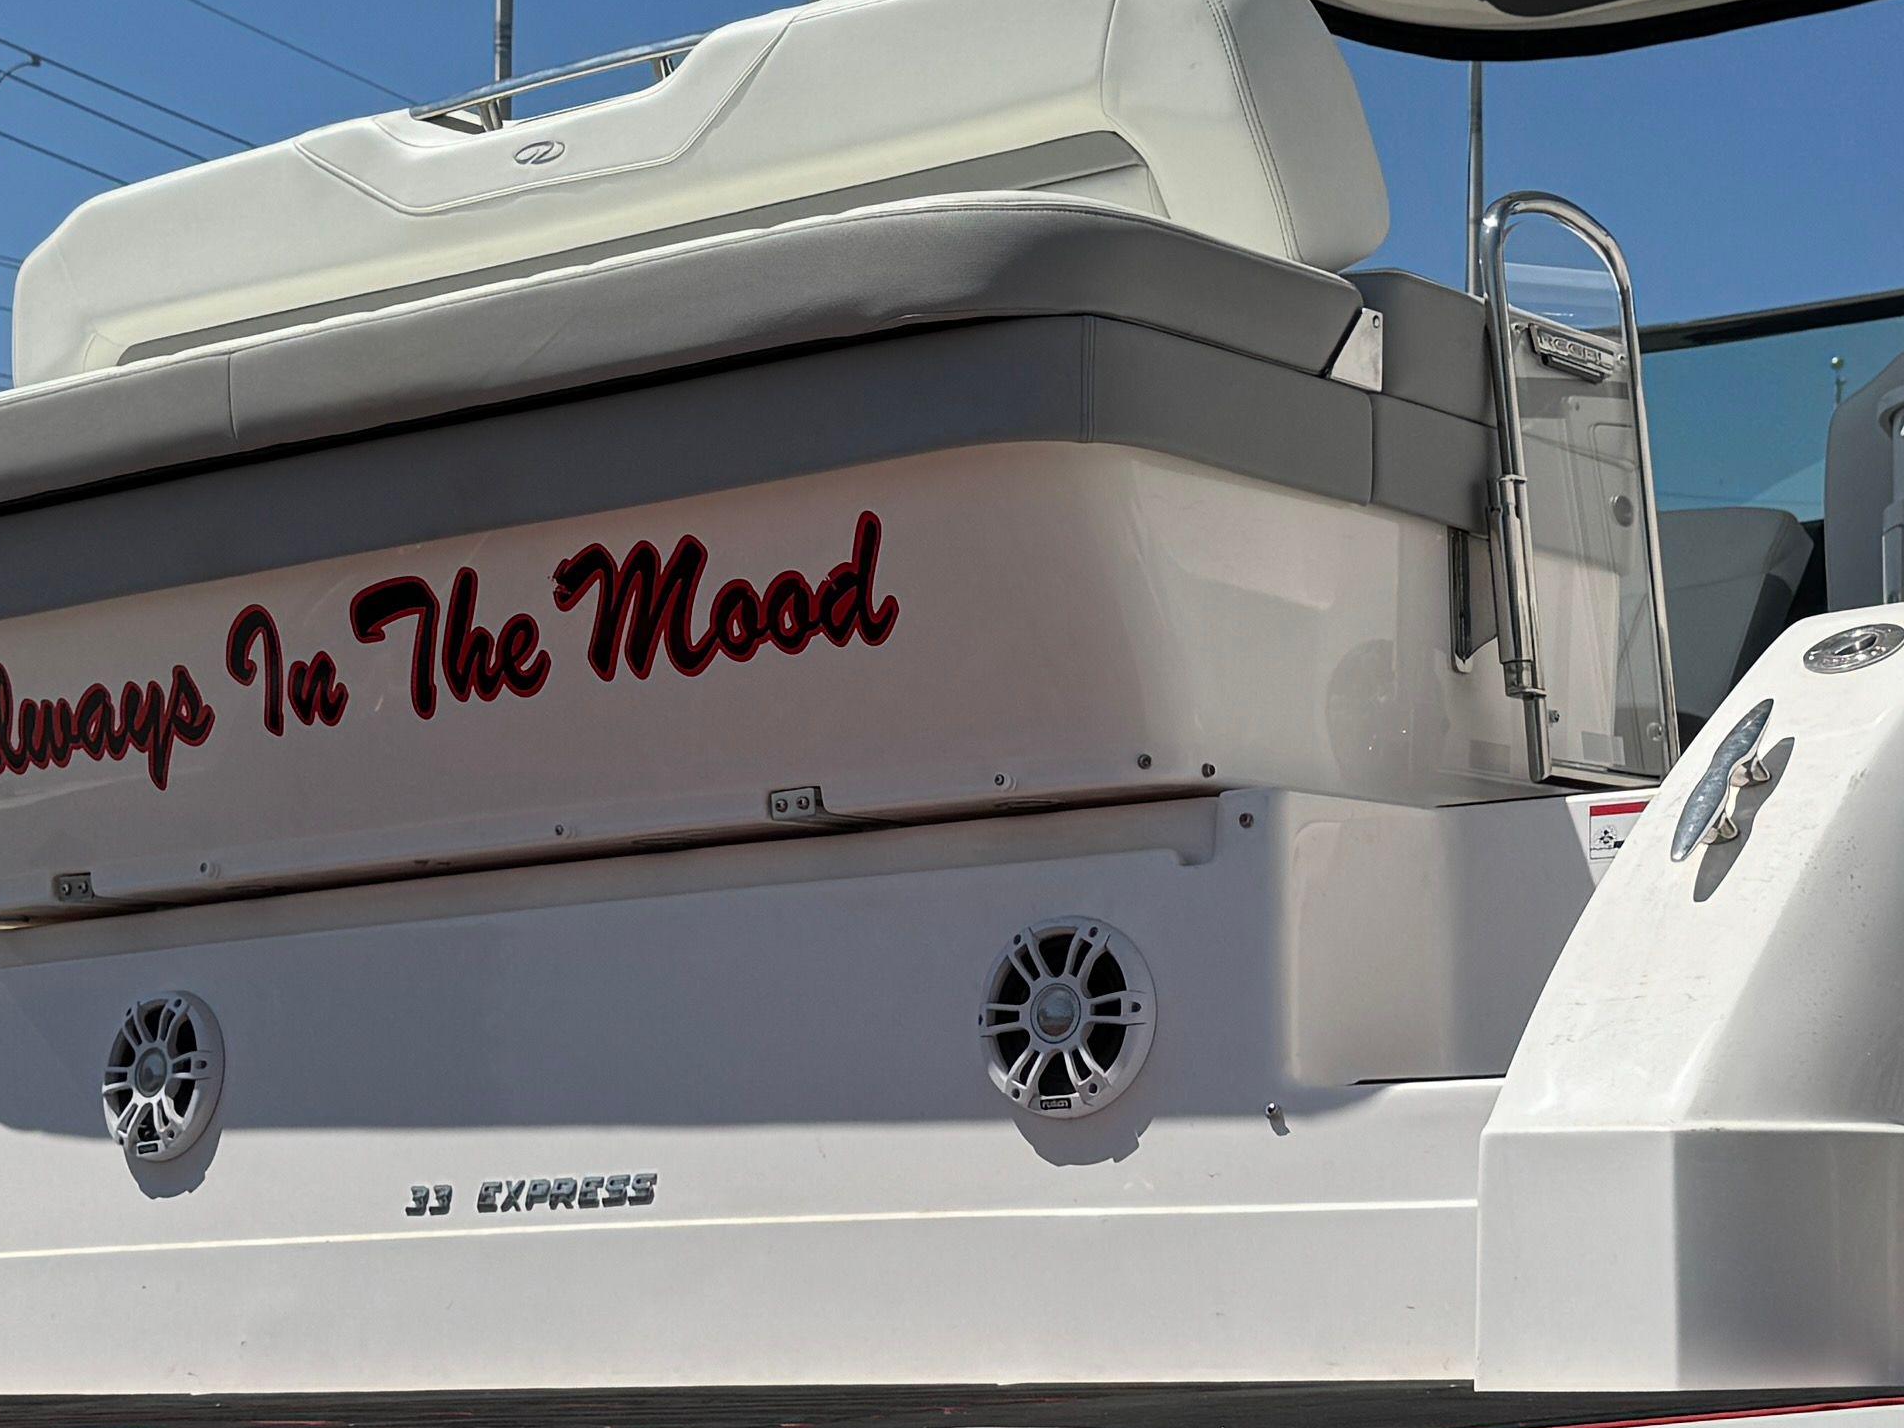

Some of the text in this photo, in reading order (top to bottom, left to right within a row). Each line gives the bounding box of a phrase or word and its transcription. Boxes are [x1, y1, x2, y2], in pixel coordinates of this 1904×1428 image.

[227, 604, 348, 736] In
[350, 567, 551, 720] The
[548, 510, 900, 680] Mood
[405, 1172, 658, 1216] 33 EXPRESS
